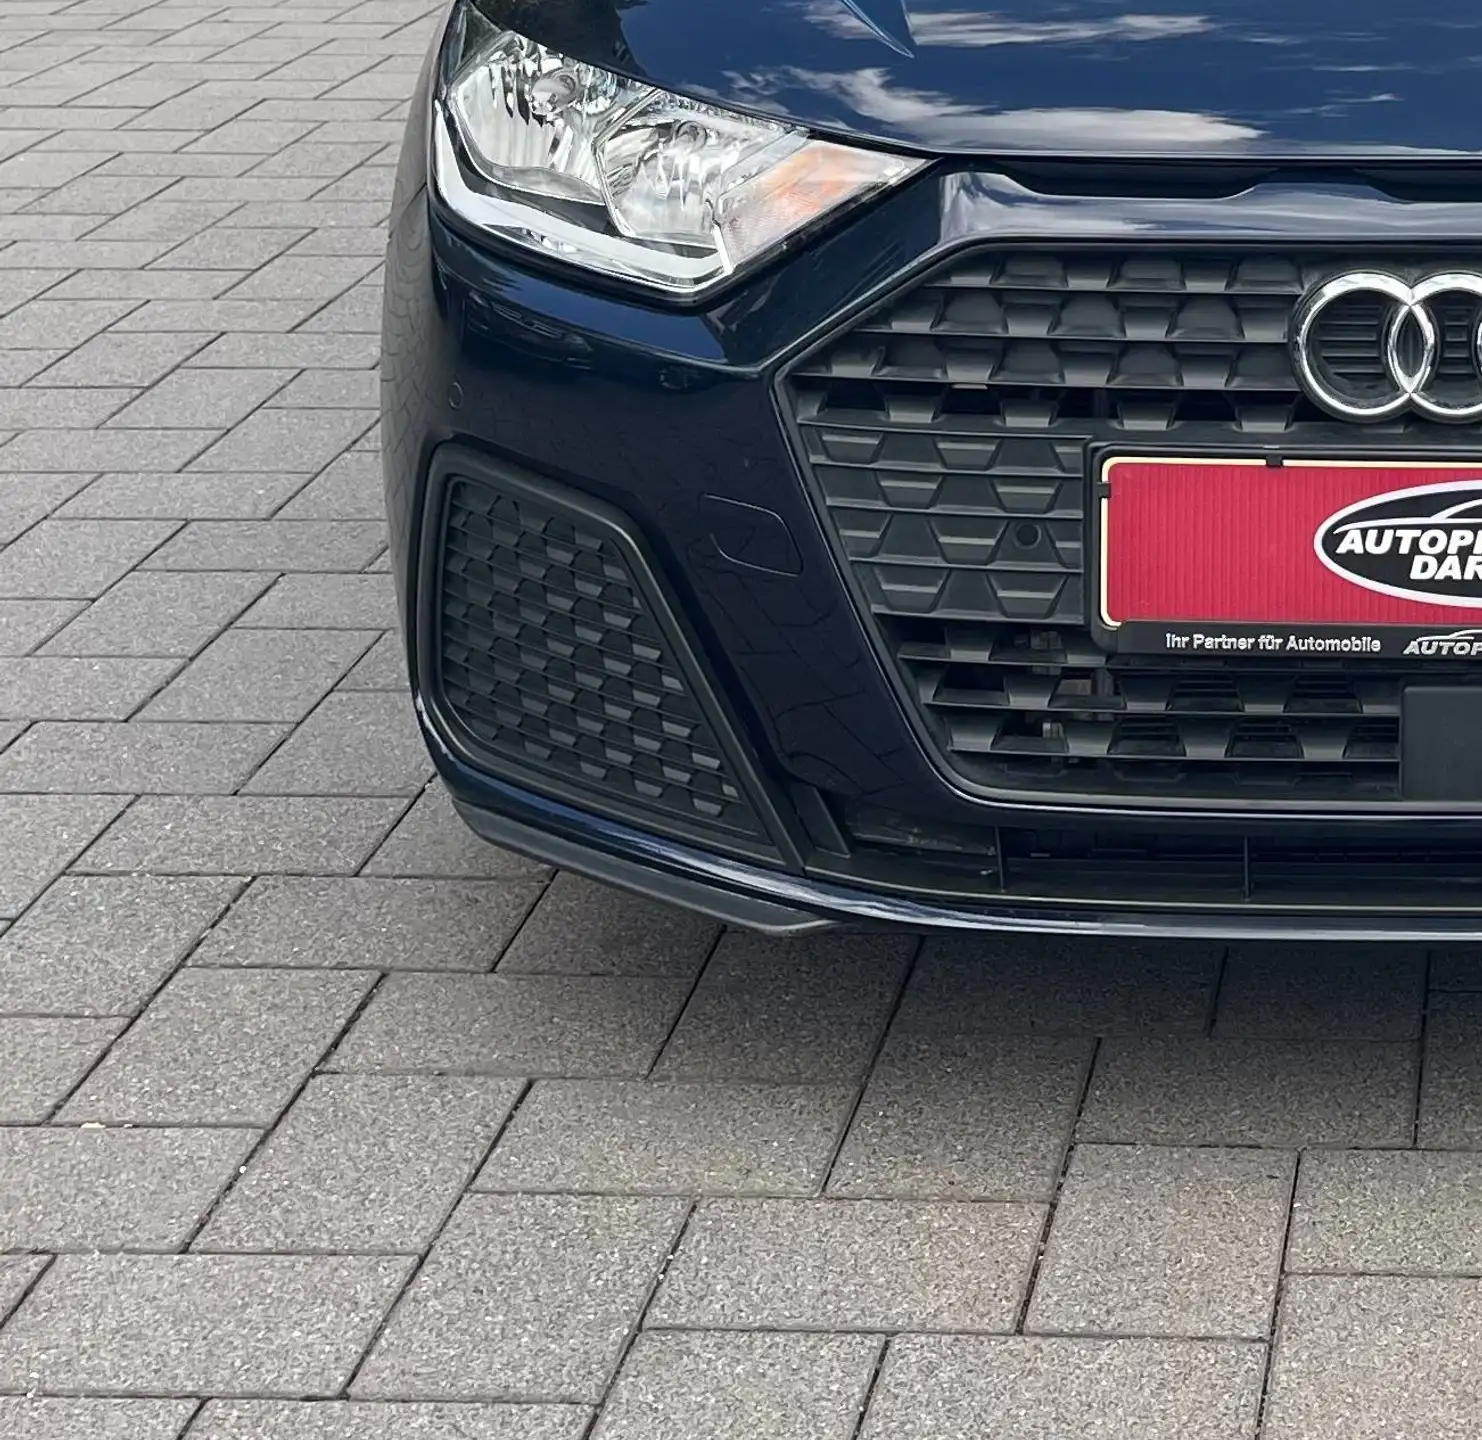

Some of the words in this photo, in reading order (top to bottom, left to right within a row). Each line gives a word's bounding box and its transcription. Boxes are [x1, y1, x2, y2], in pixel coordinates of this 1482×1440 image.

[1165, 632, 1190, 649] Ihr
[1192, 633, 1255, 651] Partner
[1257, 633, 1284, 651] für
[1286, 634, 1382, 653] Automobile
